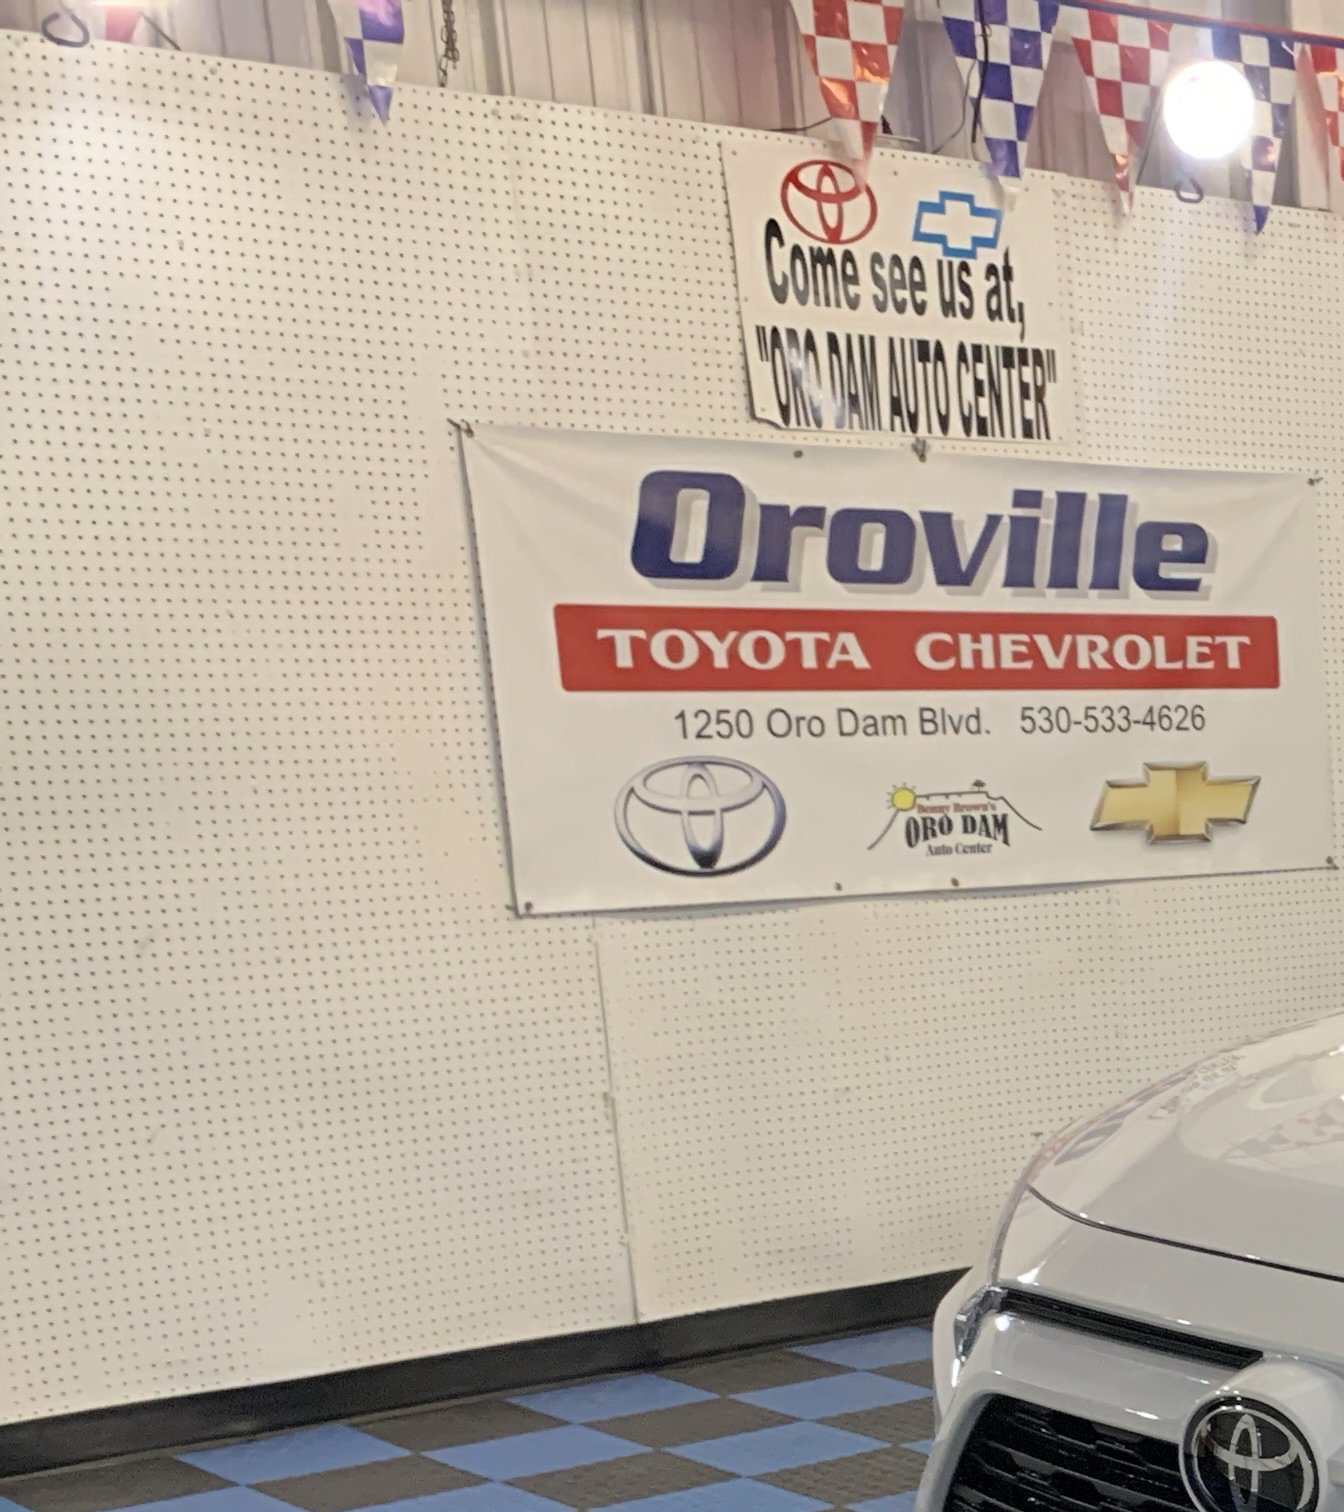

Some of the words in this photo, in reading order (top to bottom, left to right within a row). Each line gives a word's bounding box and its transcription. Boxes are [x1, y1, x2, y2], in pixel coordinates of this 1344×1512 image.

[765, 218, 860, 311] Come
[871, 251, 927, 314] see
[938, 258, 974, 320] us
[985, 247, 1026, 342] at,
[827, 331, 882, 430] DAM
[890, 337, 950, 436] AUTO
[957, 341, 1058, 440] CENTER"
[630, 470, 1210, 592] Oroville
[597, 628, 871, 670] TOYOTA
[914, 631, 1251, 671] CHEVROLET
[675, 709, 754, 740] 1250
[766, 709, 825, 739] Oro
[837, 708, 907, 738] Dam
[919, 707, 991, 737] Blvd.
[1020, 704, 1206, 735] 530-533-4626
[905, 814, 953, 848] ORO
[962, 813, 1010, 847] DAM
[926, 844, 952, 857] Auto
[955, 842, 993, 855] Center
